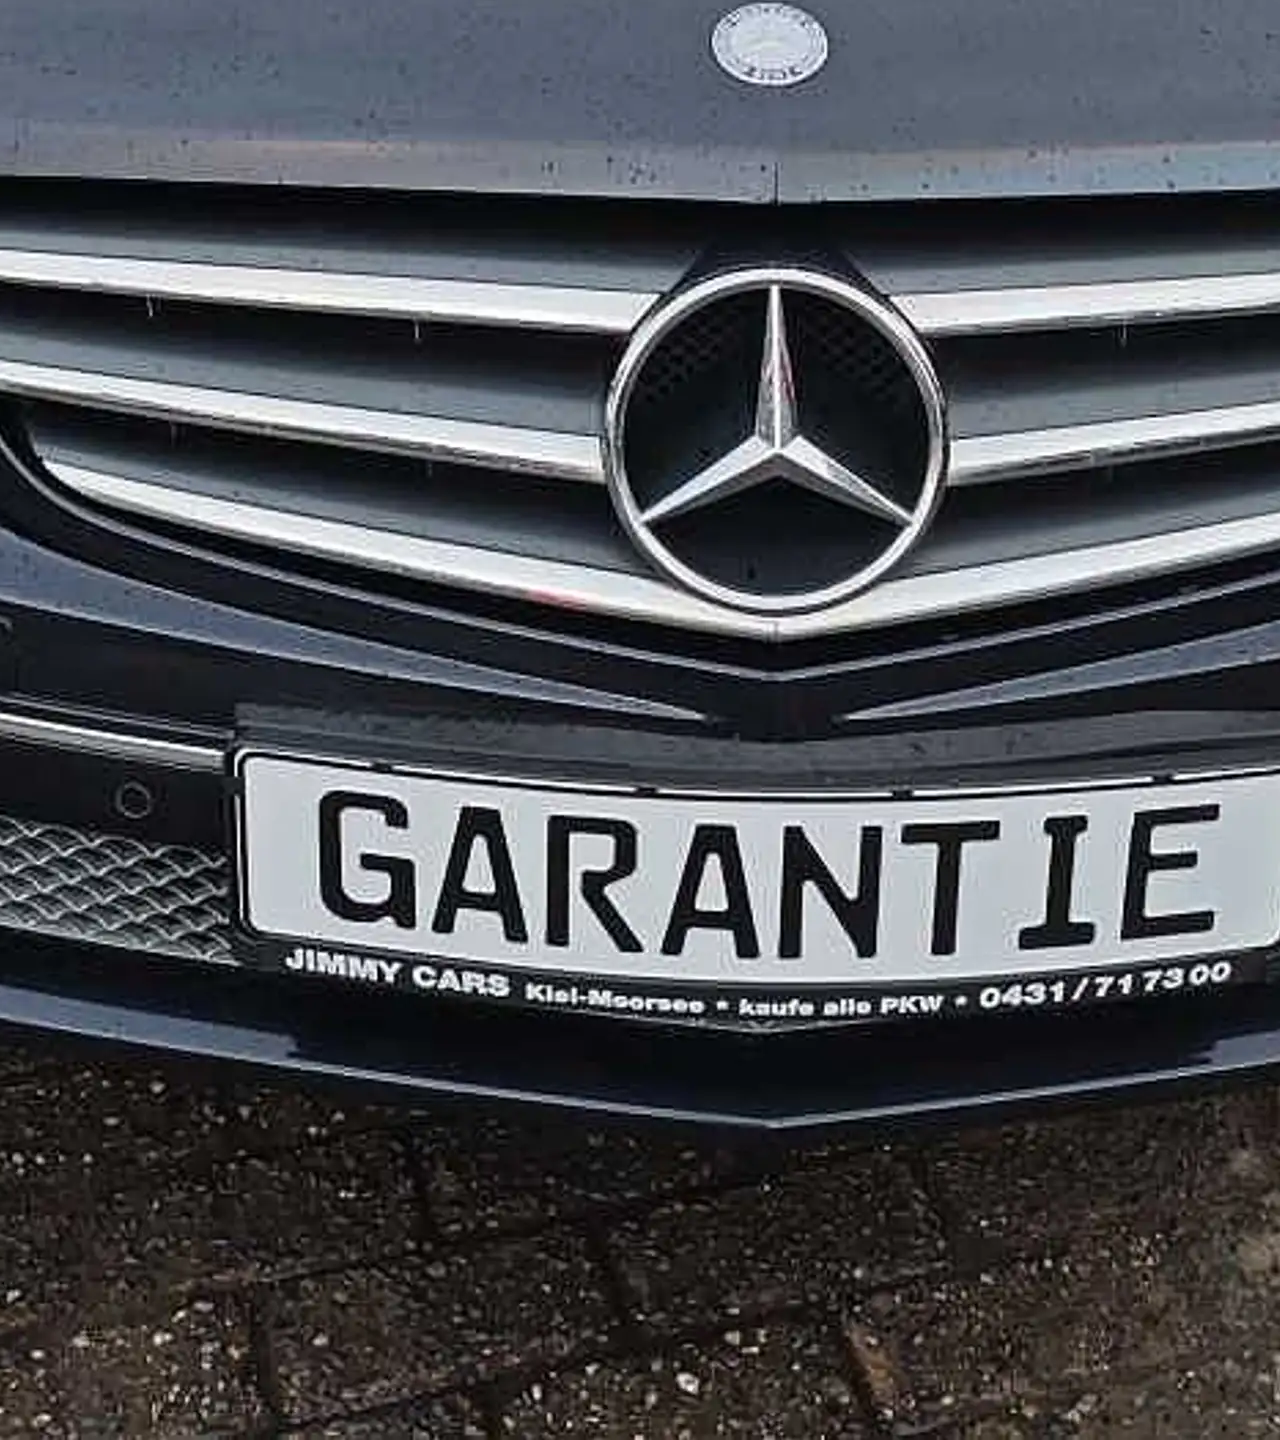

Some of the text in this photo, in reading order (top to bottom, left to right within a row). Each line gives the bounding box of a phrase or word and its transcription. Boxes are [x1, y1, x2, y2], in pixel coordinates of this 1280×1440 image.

[320, 789, 1221, 960] GARANTIE
[285, 948, 402, 985] JIMMY
[412, 964, 510, 998] CARS
[739, 997, 815, 1016] kaufe
[880, 995, 945, 1015] PKW
